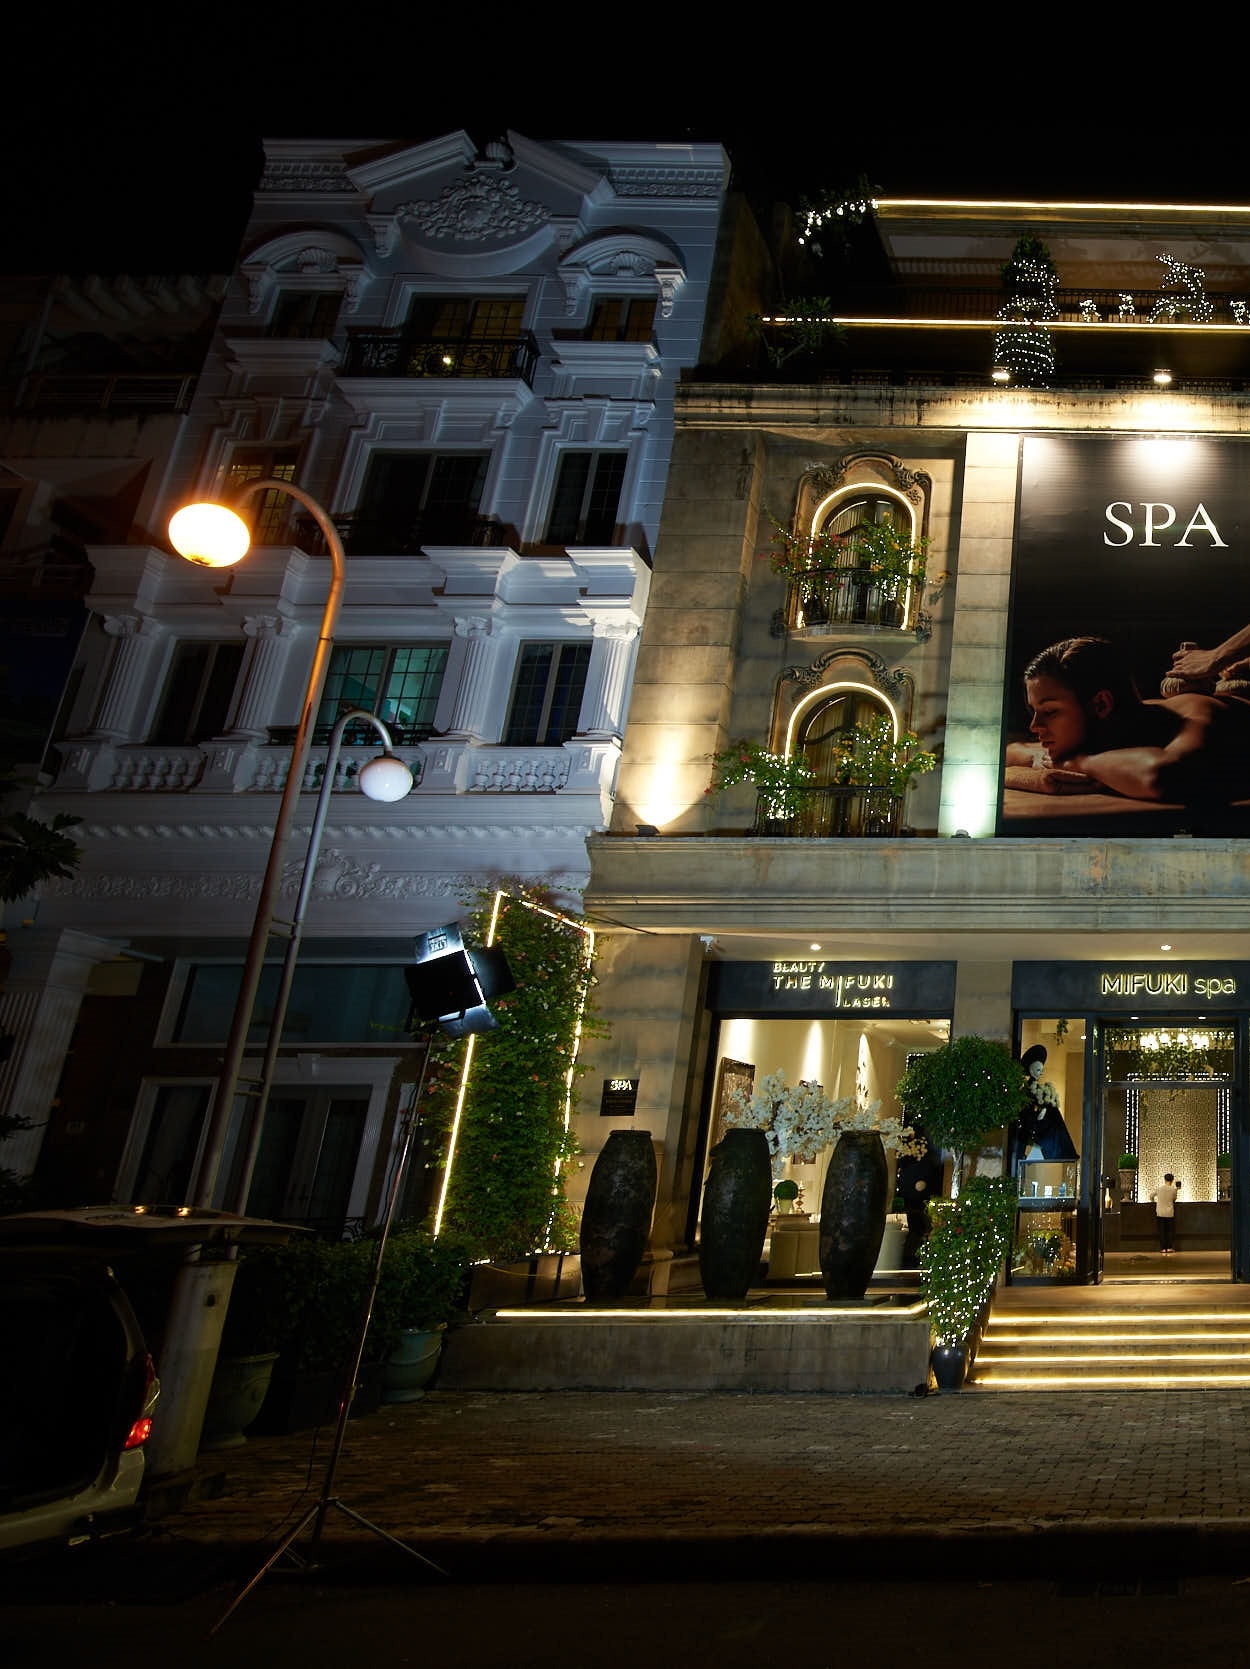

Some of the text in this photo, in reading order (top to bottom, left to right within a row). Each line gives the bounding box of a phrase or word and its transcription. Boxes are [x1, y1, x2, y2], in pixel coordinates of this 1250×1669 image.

[1103, 501, 1230, 548] SPA
[773, 975, 812, 990] THE
[1101, 974, 1236, 1000] MIFUKI spa
[842, 996, 890, 1008] LASER
[610, 1079, 632, 1091] SPA
